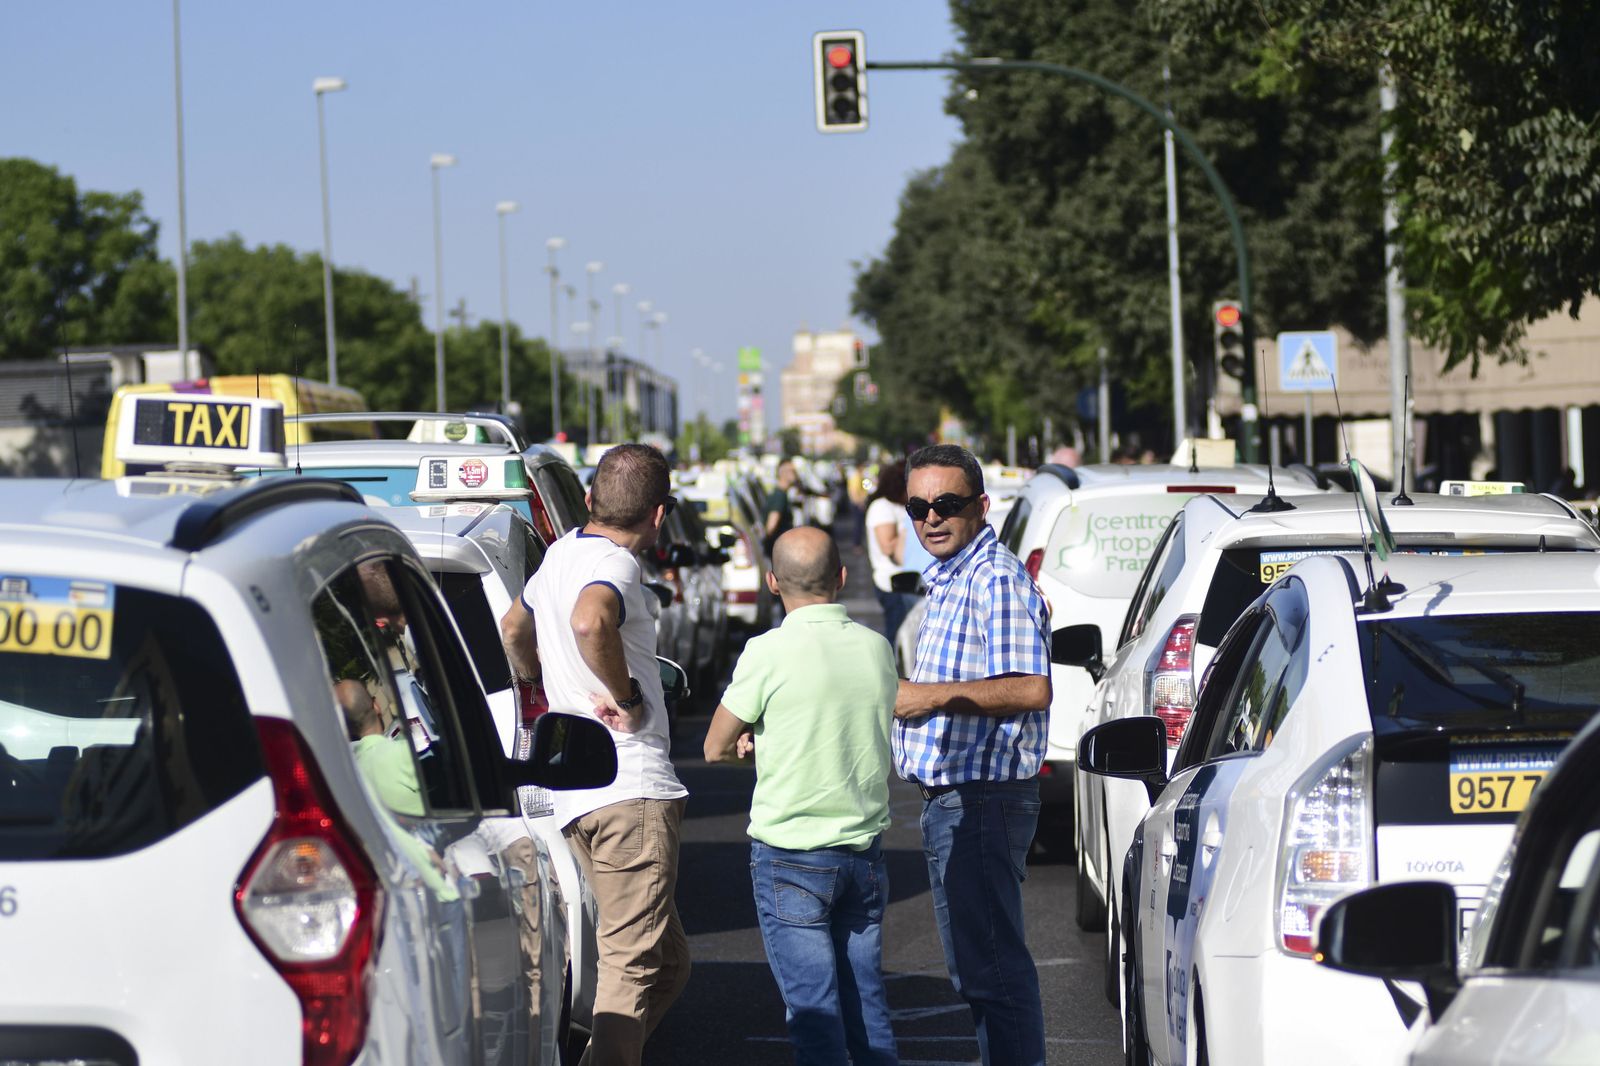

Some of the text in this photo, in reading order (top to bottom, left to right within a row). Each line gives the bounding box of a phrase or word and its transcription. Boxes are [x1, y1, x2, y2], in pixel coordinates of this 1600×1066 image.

[168, 402, 250, 448] TAXI
[1094, 513, 1172, 530] centro
[54, 611, 103, 652] 00
[1457, 775, 1516, 810] 957
[1406, 860, 1465, 873] TOYOTA
